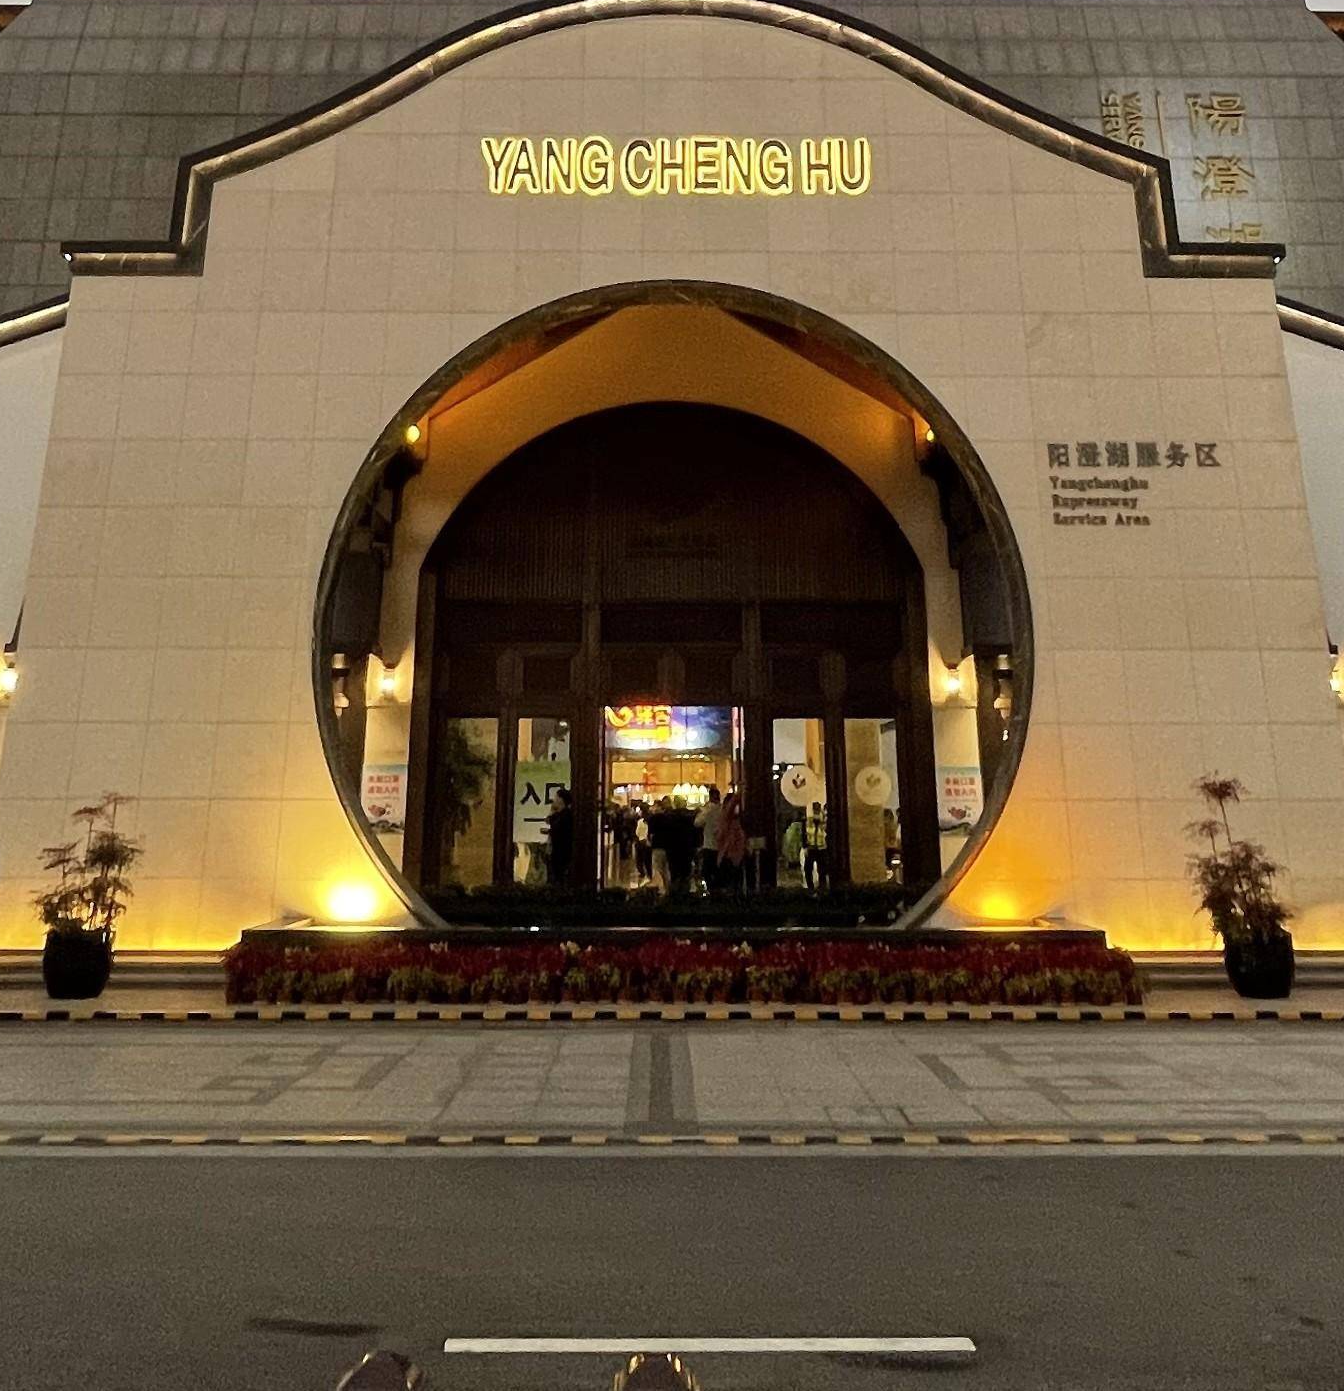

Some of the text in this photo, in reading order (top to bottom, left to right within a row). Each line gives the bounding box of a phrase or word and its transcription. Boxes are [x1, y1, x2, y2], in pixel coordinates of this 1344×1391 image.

[481, 135, 872, 196] YANG CHENG HU
[1047, 441, 1221, 468] 阳澄湖服务区
[1049, 476, 1149, 491] Yangchenghu
[1115, 512, 1150, 526] Area
